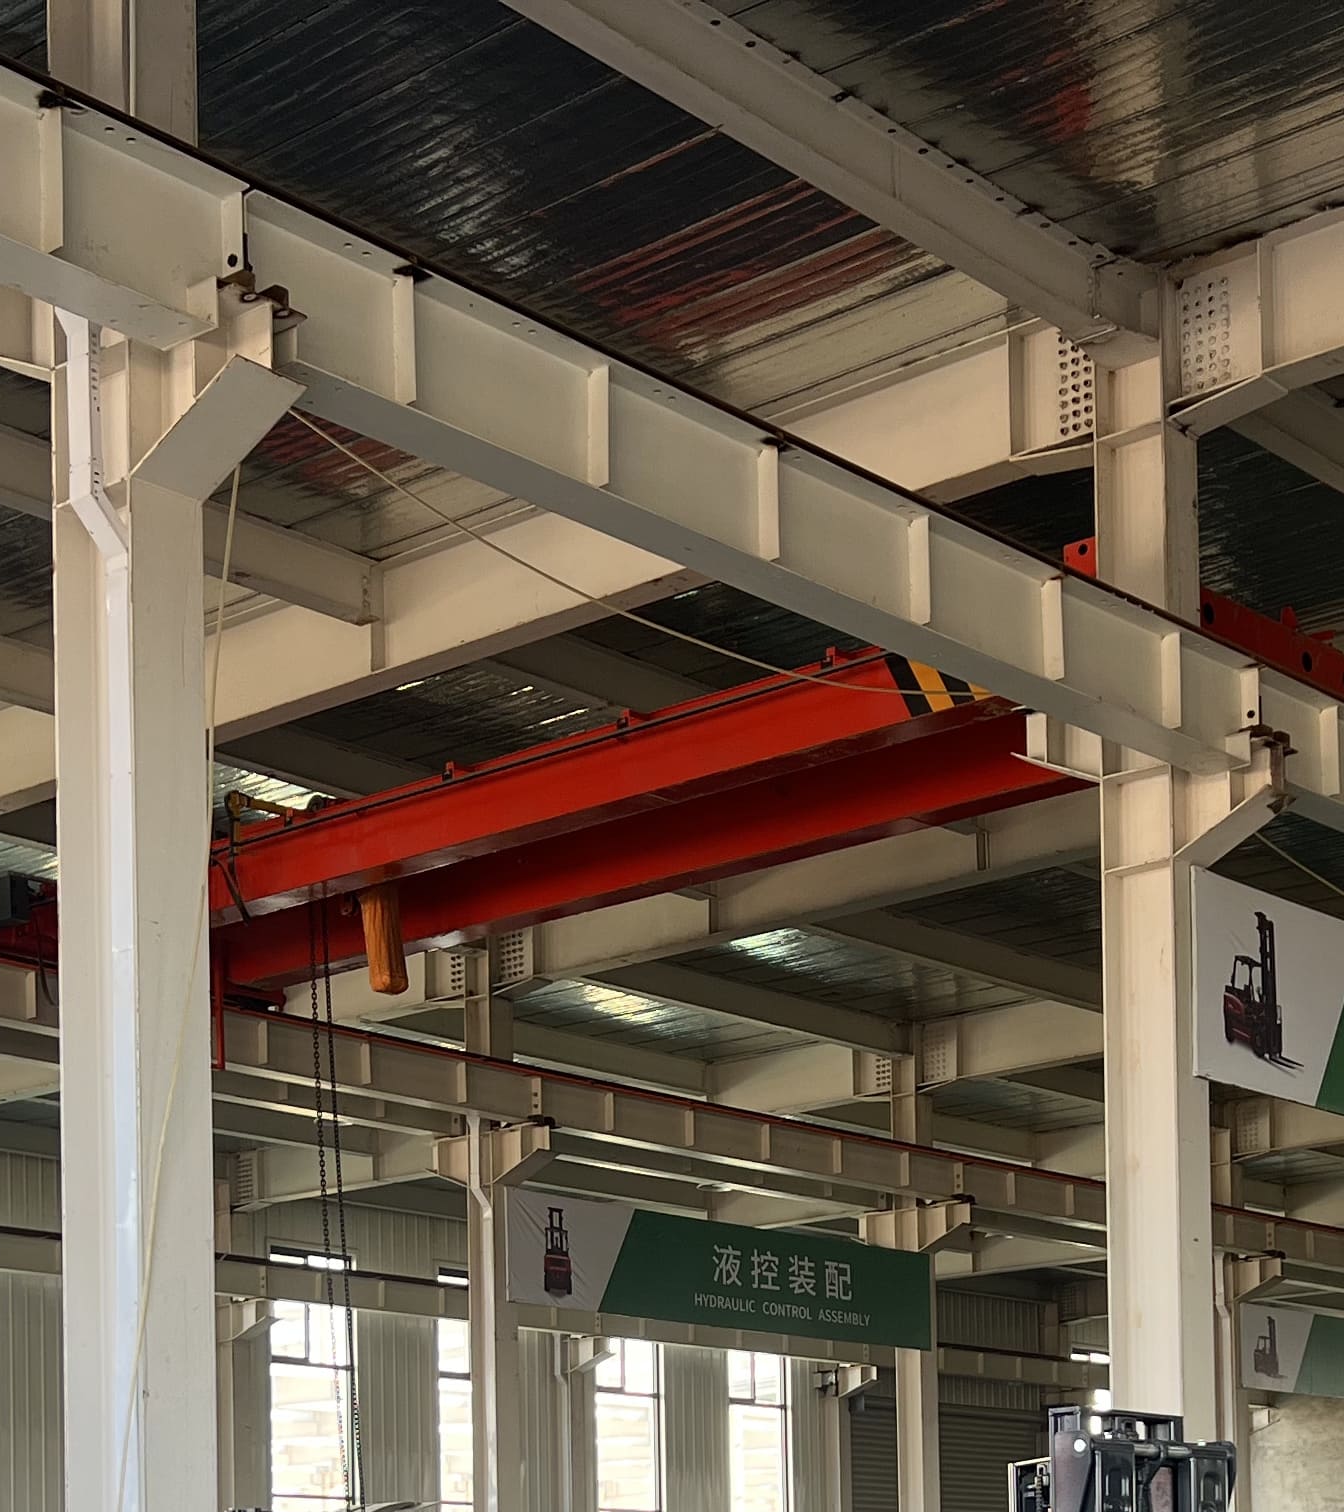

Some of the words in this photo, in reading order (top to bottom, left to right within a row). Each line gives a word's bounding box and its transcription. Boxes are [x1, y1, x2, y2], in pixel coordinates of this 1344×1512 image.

[712, 1244, 853, 1301] 液控装配
[694, 1292, 756, 1313] HYDRAULIC
[762, 1301, 813, 1320] CONTROL
[818, 1308, 871, 1327] ASSEMBLY
